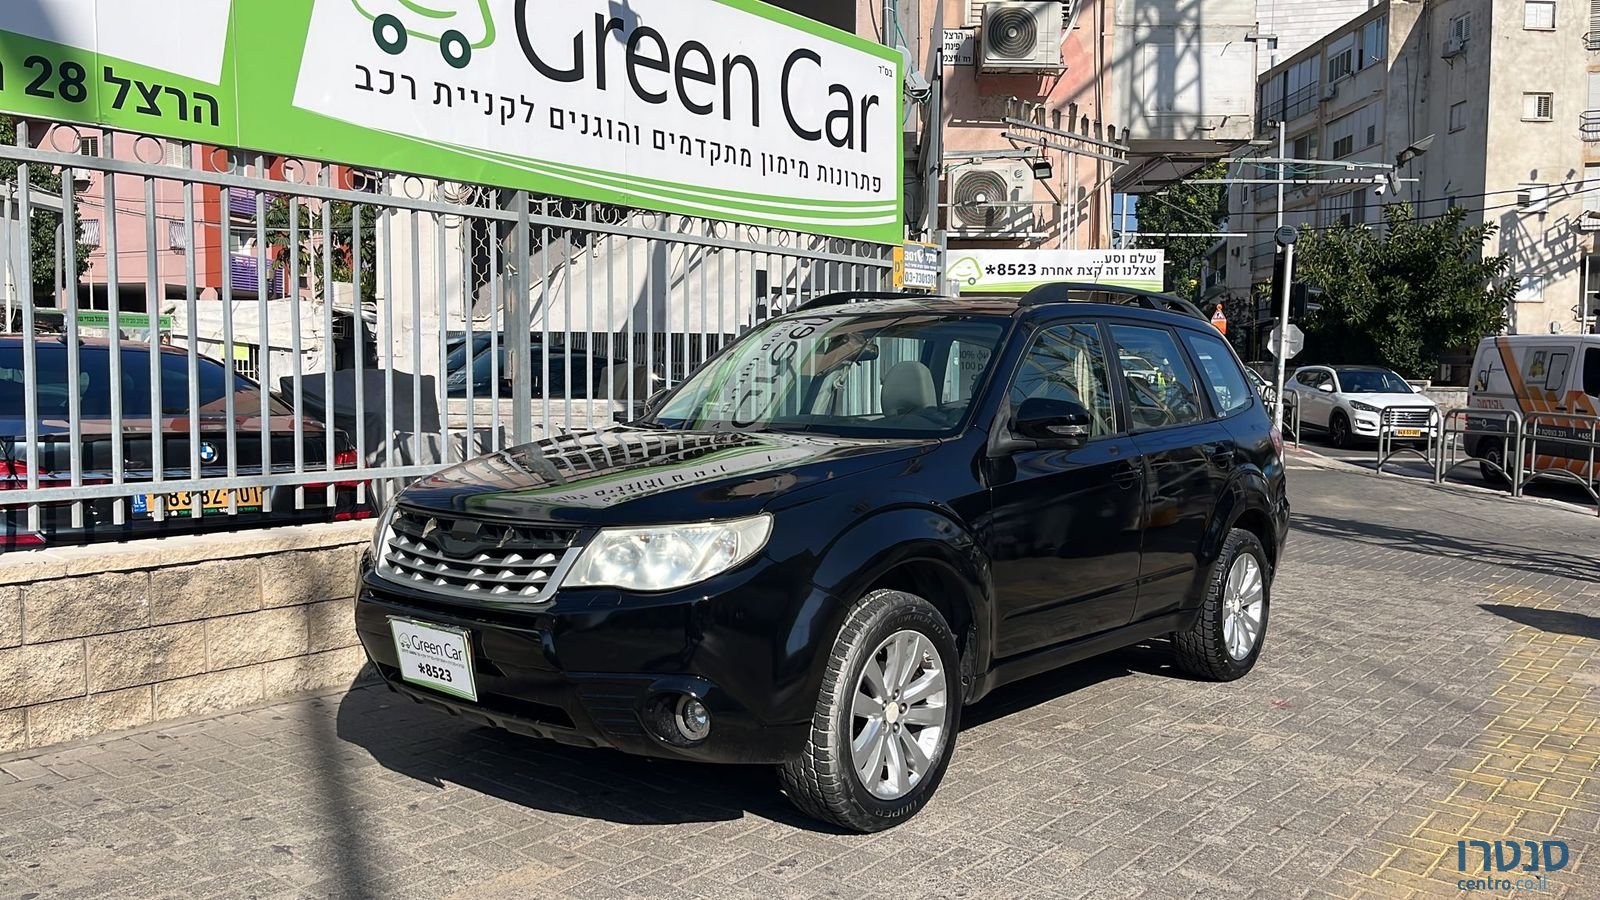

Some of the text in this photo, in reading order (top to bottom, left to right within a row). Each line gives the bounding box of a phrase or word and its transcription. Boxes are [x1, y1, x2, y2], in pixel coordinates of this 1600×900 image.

[944, 30, 964, 40] הרצל
[944, 42, 961, 50] פינת
[23, 55, 88, 103] 28
[514, 0, 880, 153] Green Car
[103, 66, 220, 127] הרצל
[355, 64, 882, 193] פתרונות מימון מתקדמים והוגנים לקניית רכב
[1129, 253, 1156, 264] שלם
[1040, 266, 1073, 276] אחרת
[1076, 266, 1101, 278] קצת
[1106, 266, 1118, 276] זה
[1122, 264, 1156, 276] אצלנו
[411, 635, 443, 657] Green
[444, 643, 463, 661] Car
